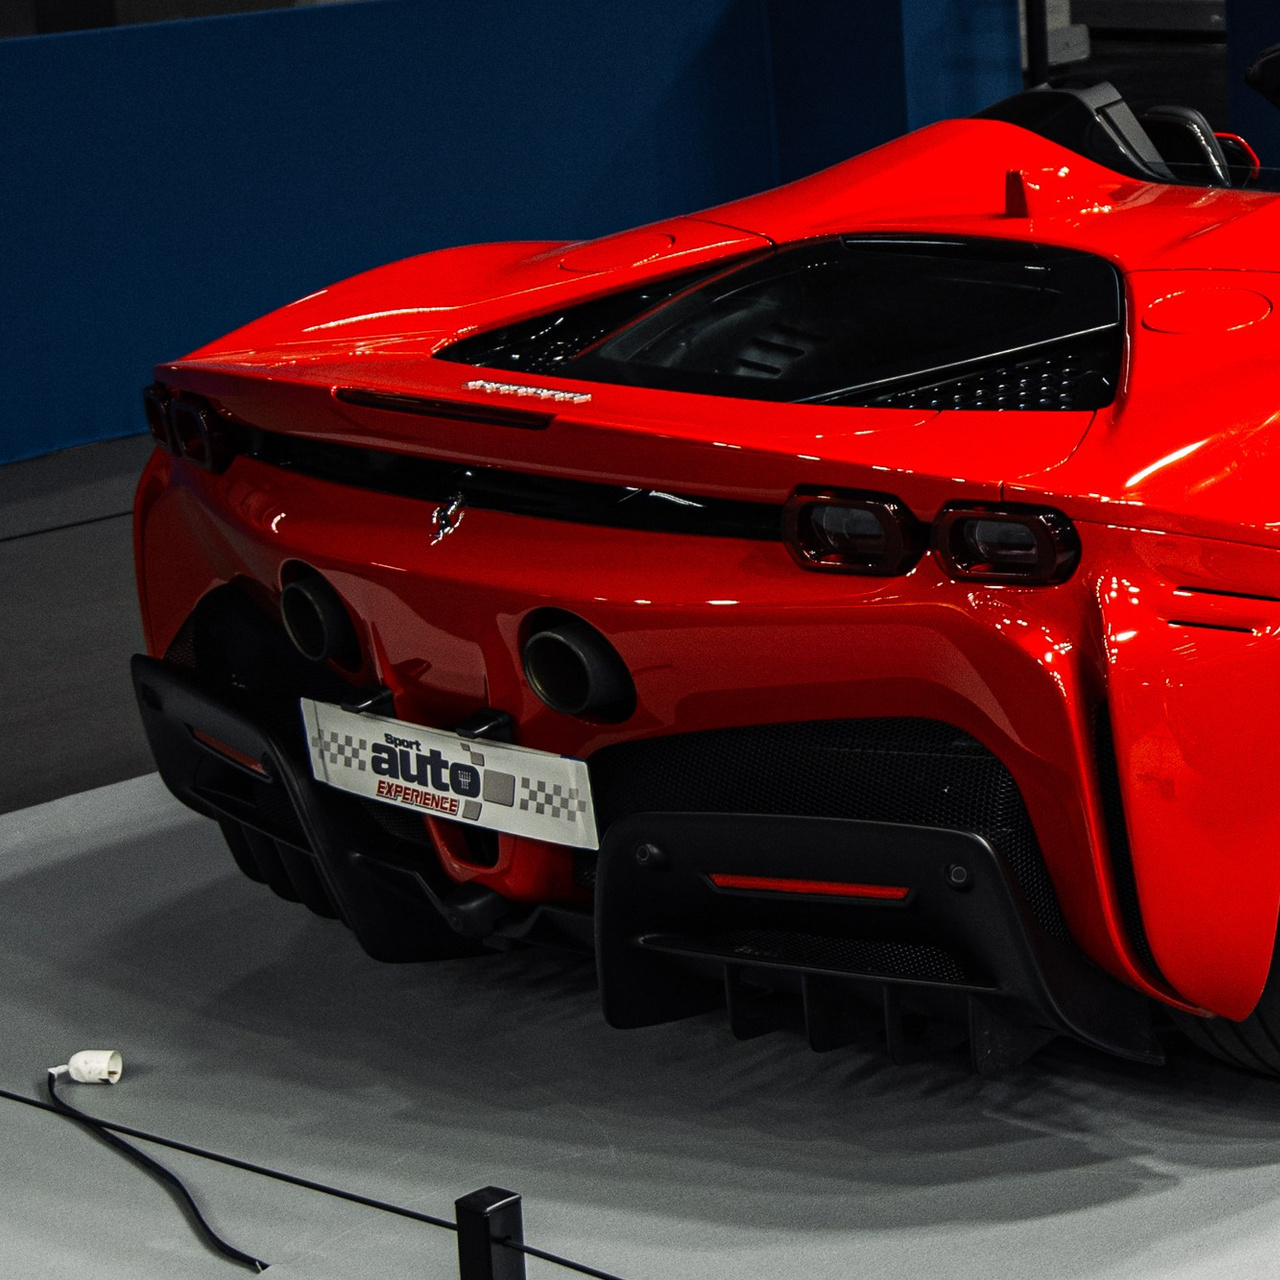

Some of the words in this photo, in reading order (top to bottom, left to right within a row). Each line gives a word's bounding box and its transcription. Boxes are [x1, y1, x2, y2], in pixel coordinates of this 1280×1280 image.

[384, 732, 421, 752] Sport
[371, 741, 481, 798] auto
[375, 779, 459, 815] EXPERIENCE
